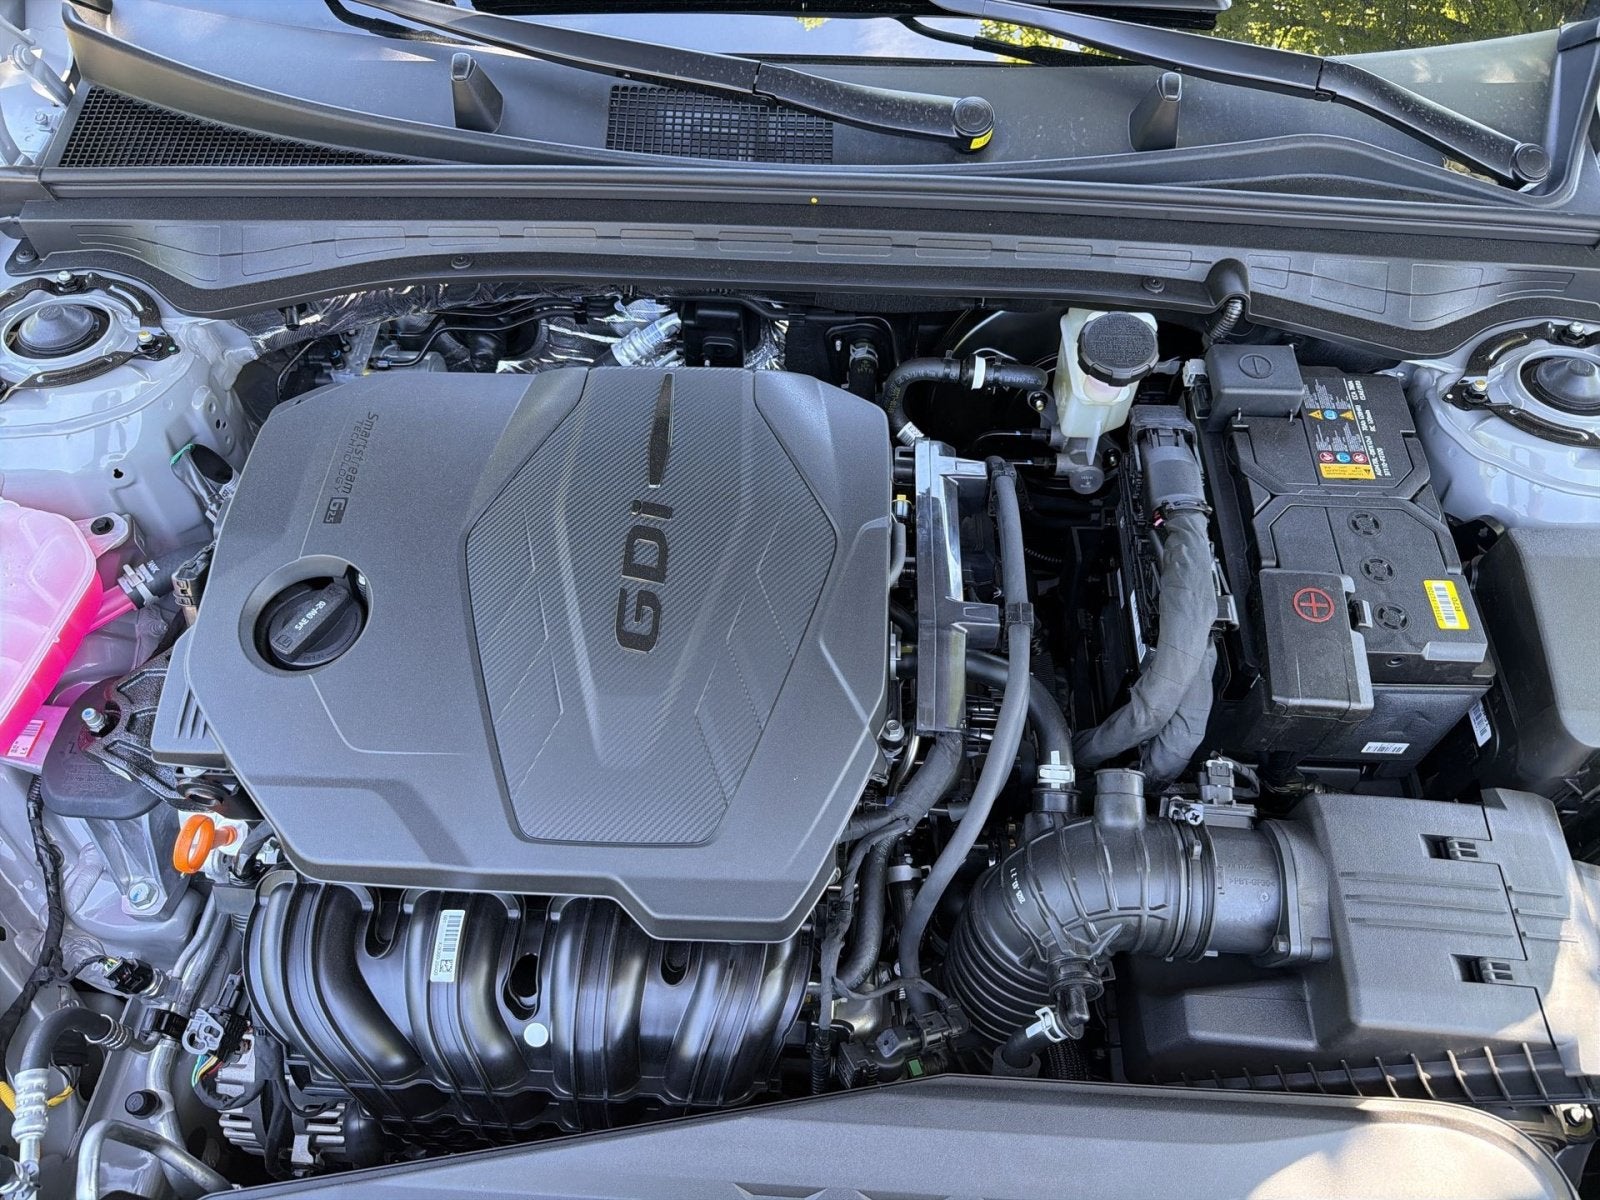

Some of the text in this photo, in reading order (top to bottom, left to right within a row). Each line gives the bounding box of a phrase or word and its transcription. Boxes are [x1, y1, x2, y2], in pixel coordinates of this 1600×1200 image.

[335, 420, 364, 493] TECHNOLOGY
[342, 411, 379, 494] Smartstream
[615, 499, 673, 655] GDi
[1451, 597, 1462, 612] R70
[294, 600, 327, 631] SAE 0W-20
